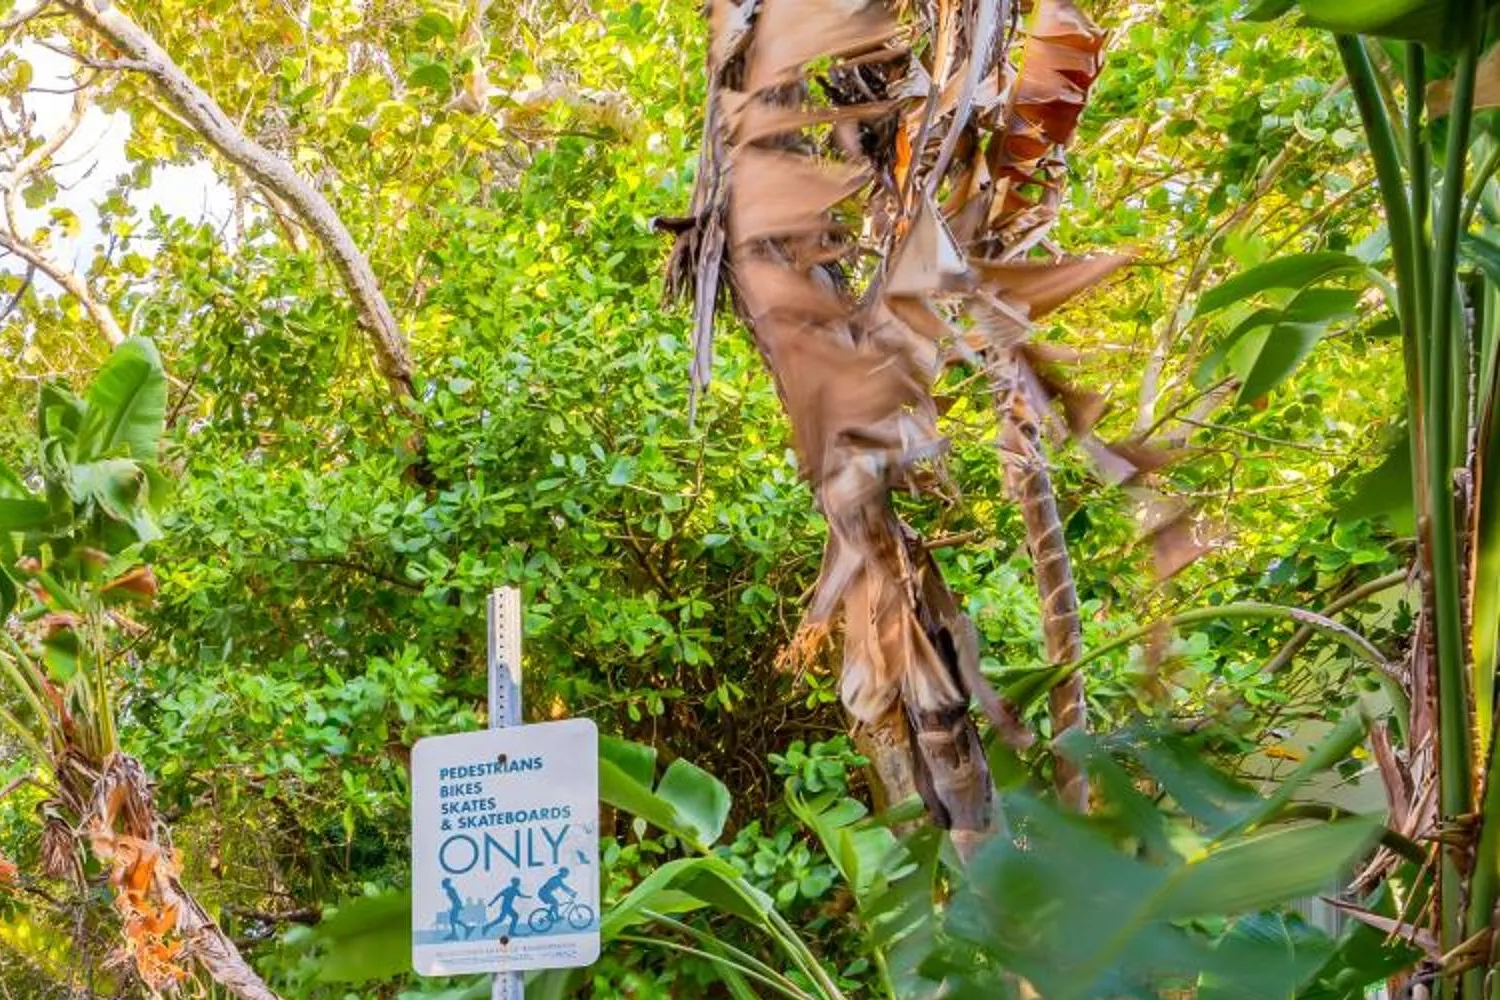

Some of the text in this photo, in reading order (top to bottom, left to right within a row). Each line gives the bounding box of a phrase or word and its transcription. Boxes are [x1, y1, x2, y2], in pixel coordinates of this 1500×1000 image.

[439, 757, 544, 781] PEDESTRIANS
[439, 781, 483, 799] BIKES
[440, 797, 497, 815] SKATES
[440, 805, 572, 831] & SKATEBOARDS
[438, 823, 571, 875] ONLY
